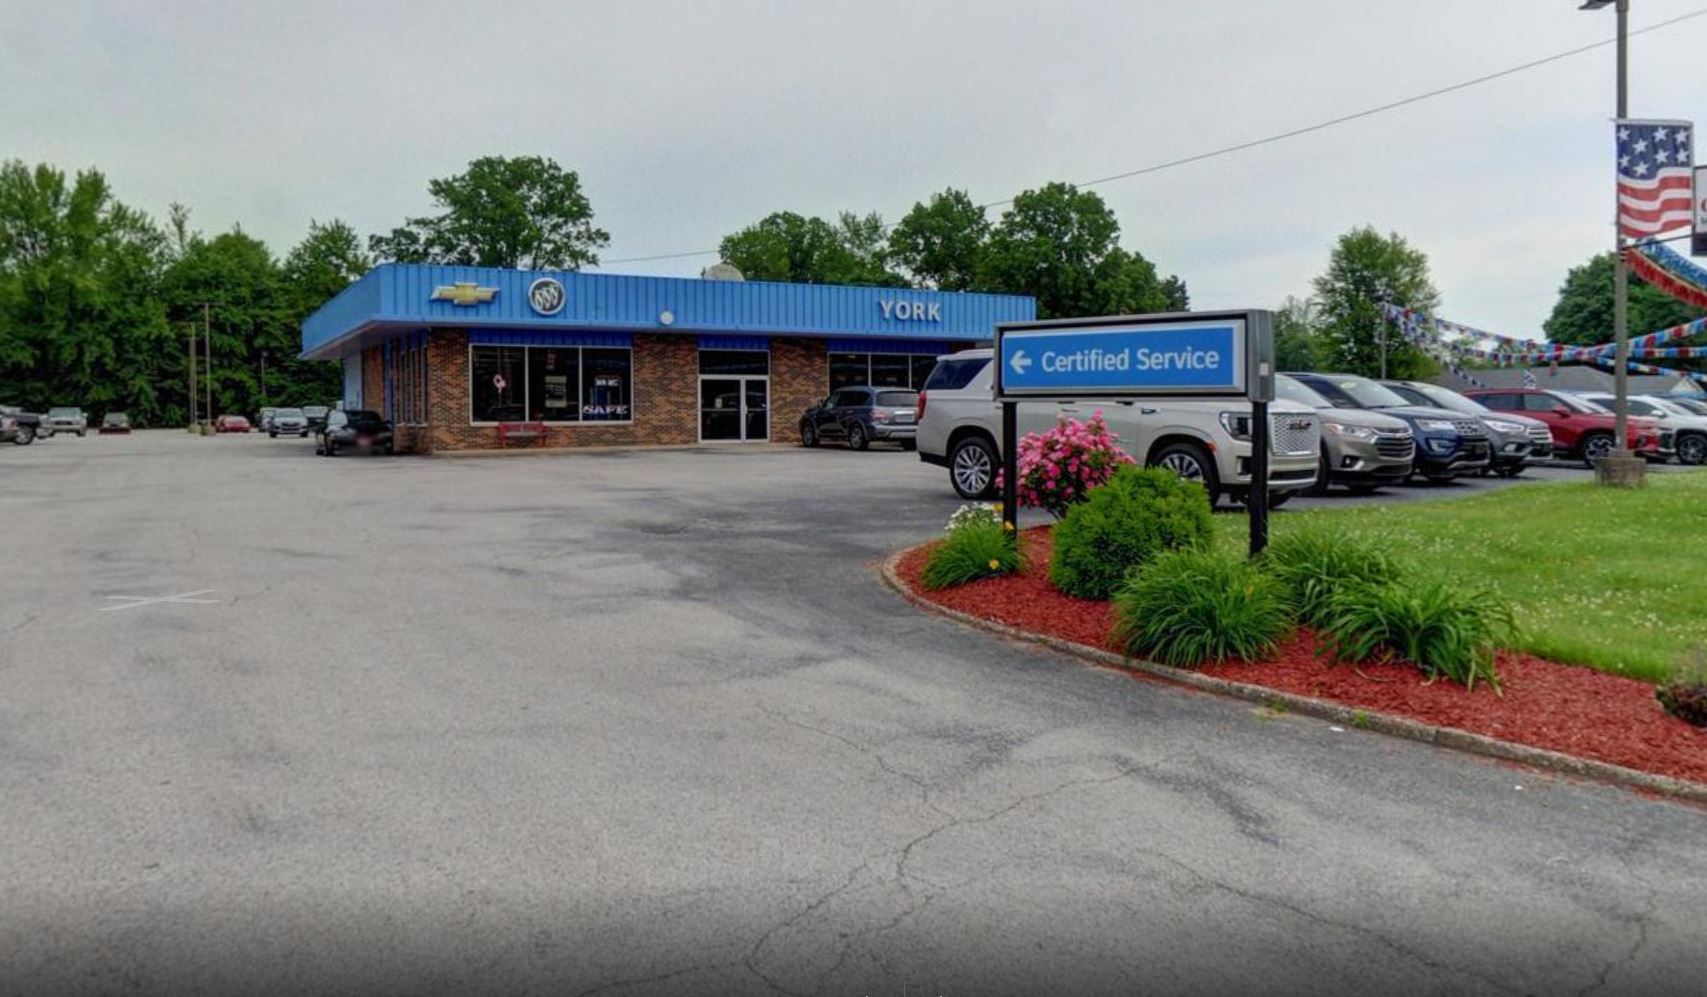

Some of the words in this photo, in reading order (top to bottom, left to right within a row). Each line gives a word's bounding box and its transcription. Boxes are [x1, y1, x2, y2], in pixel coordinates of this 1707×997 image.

[880, 300, 941, 322] YORK
[1041, 347, 1130, 373] Certified
[1136, 346, 1220, 370] Service
[582, 404, 628, 415] SAFE
